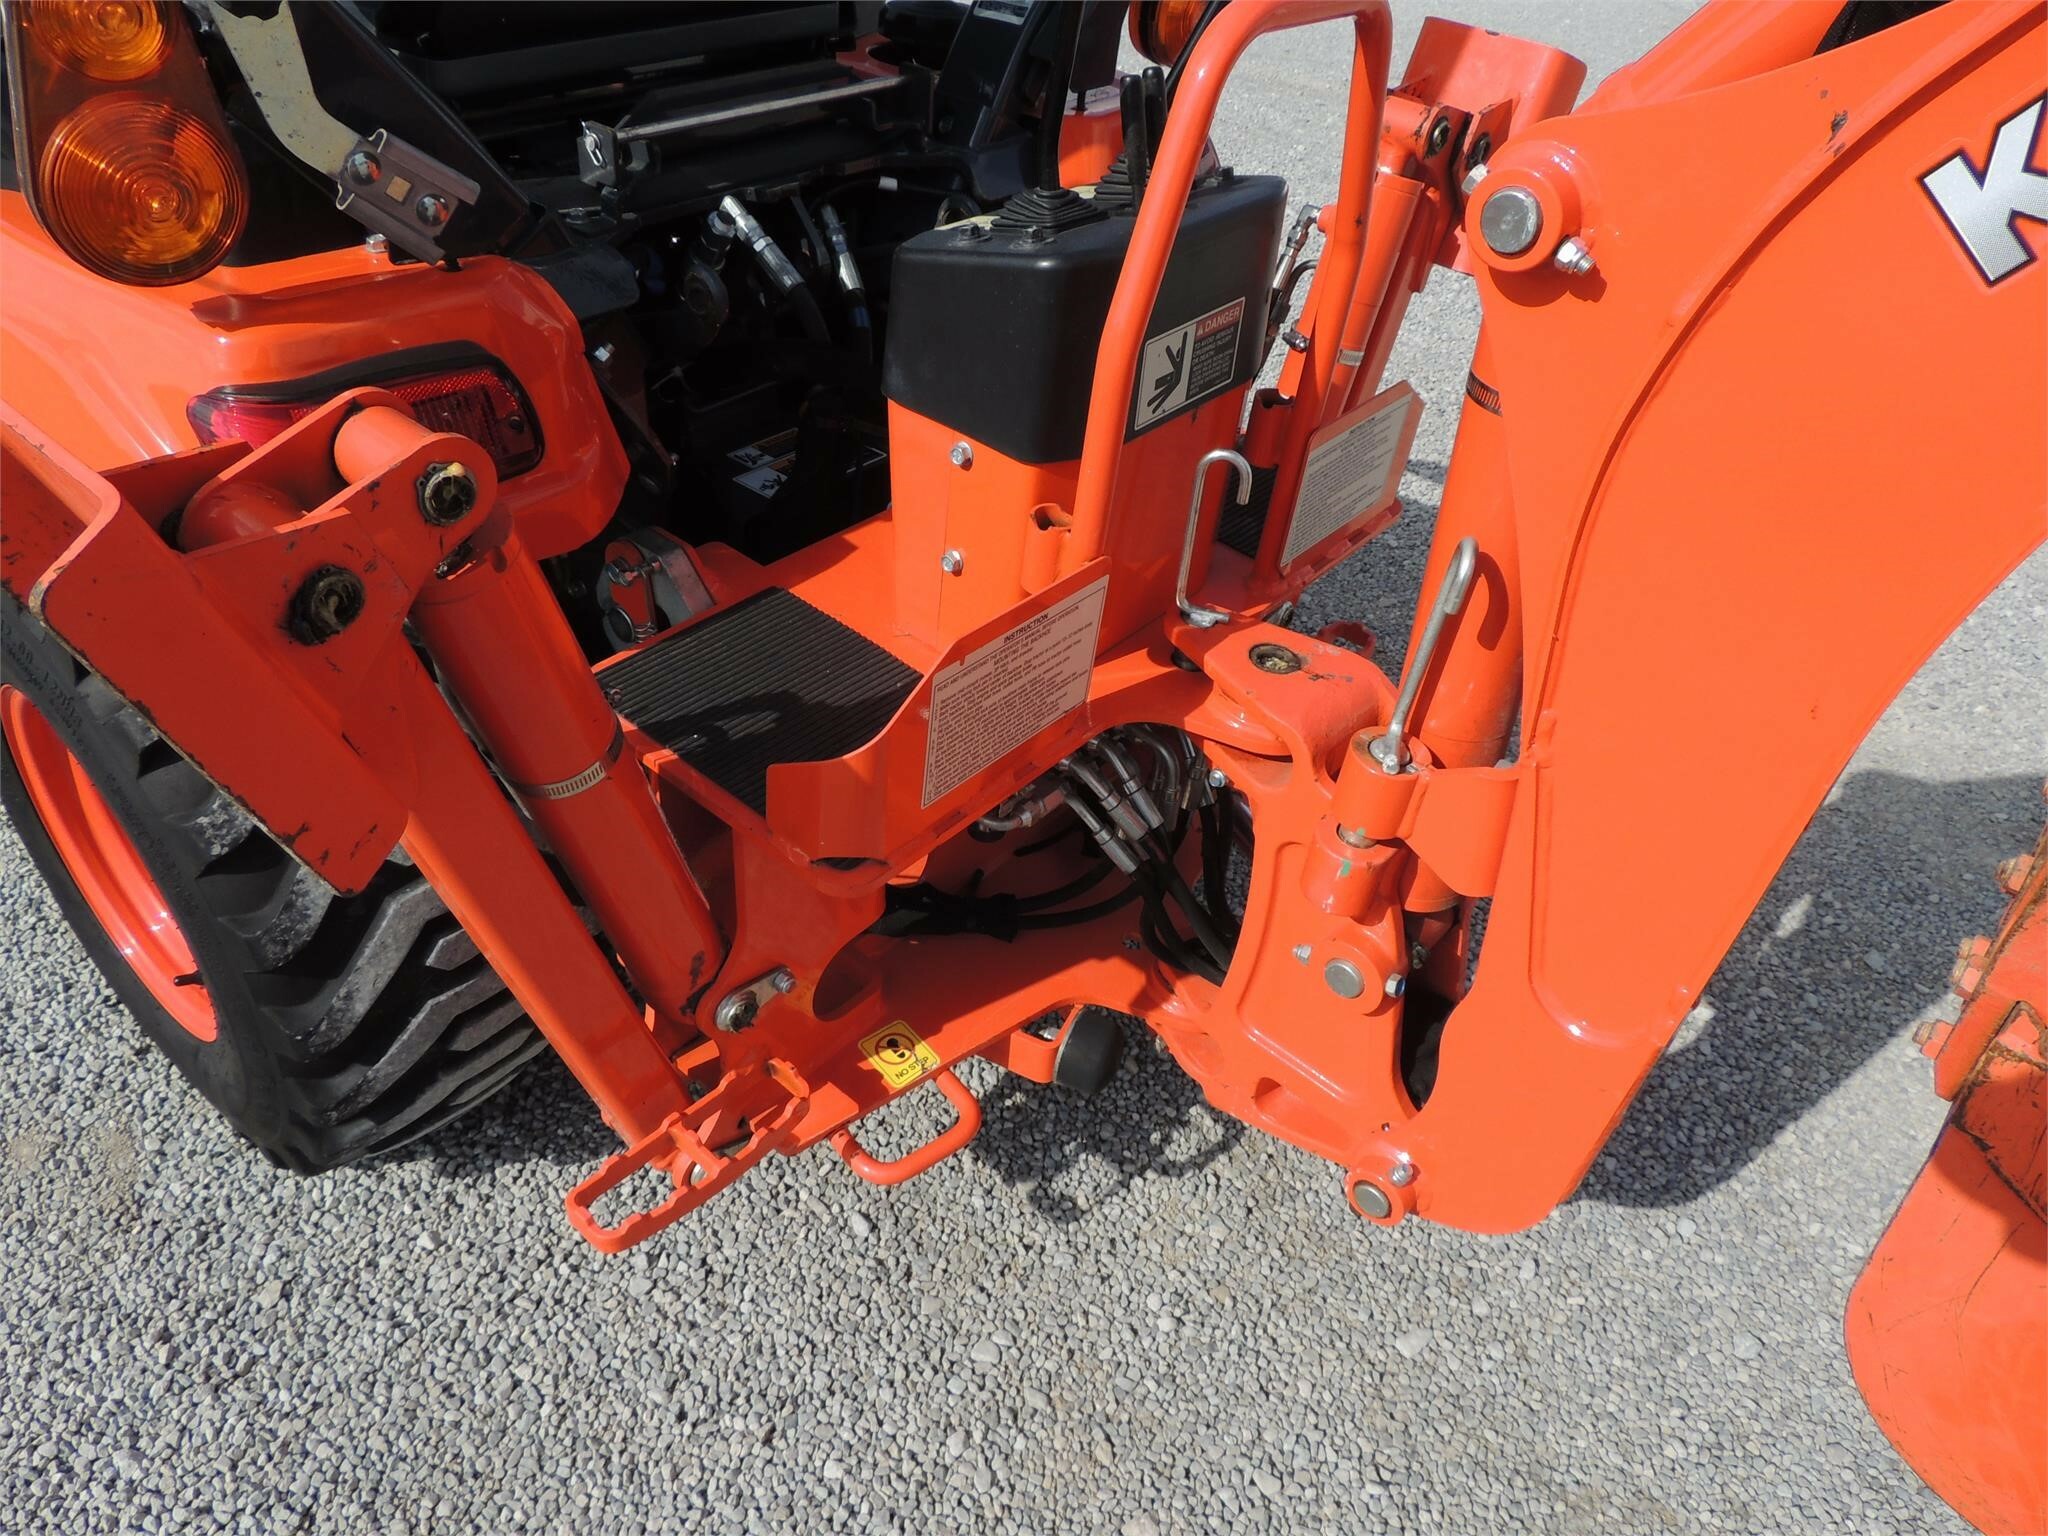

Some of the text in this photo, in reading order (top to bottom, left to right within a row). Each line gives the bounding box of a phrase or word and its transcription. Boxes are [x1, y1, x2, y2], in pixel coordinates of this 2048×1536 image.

[1205, 306, 1240, 332] DANGER
[1003, 612, 1048, 644] INSTRUCTION
[895, 1068, 909, 1079] NO
